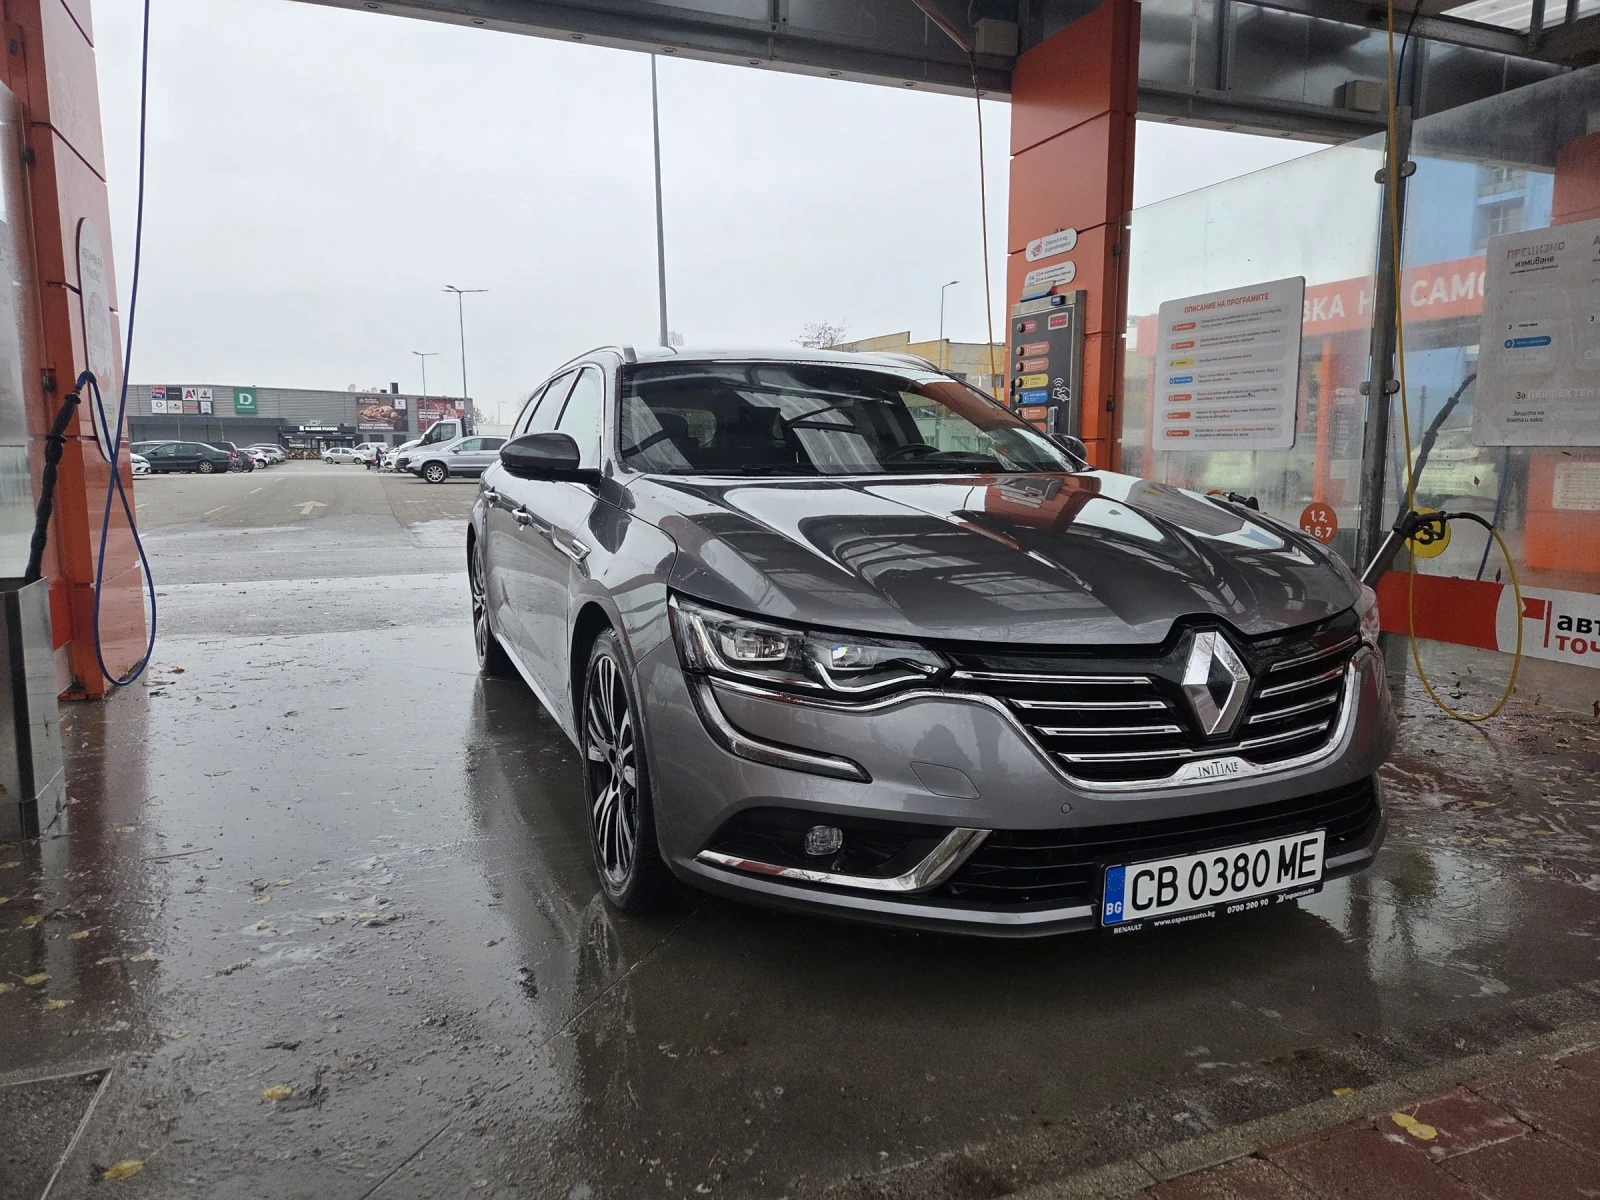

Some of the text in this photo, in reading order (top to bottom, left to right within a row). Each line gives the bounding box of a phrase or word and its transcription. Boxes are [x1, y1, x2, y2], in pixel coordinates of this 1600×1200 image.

[1507, 241, 1566, 259] ПРЕЦИЗНО
[1515, 256, 1555, 268] измиване
[1184, 292, 1270, 314] ОПИСАНИЕ НА ПРОГРАМИТЕ
[185, 389, 196, 399] A1
[239, 393, 253, 405] D
[1198, 761, 1239, 776] INITIALE
[1132, 838, 1319, 911] CB 0380 ME
[1106, 902, 1123, 916] BG
[1113, 887, 1315, 935] RENAULT www.espaceauto.bg 0700 200 90 espaceauto
